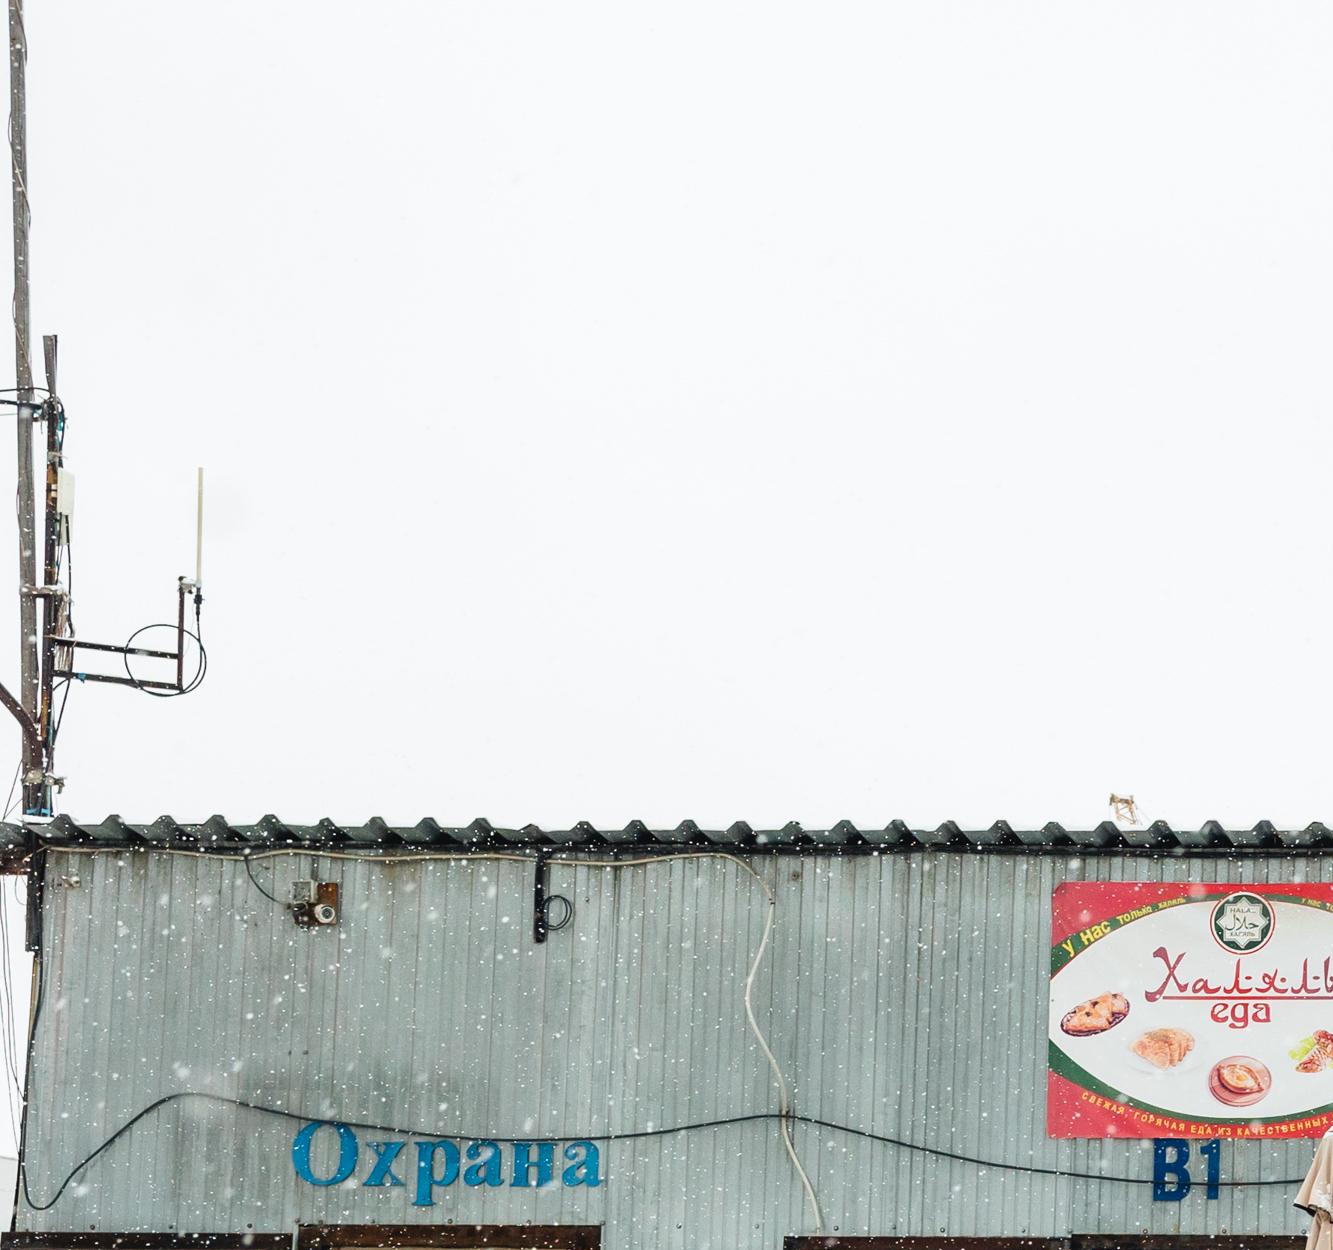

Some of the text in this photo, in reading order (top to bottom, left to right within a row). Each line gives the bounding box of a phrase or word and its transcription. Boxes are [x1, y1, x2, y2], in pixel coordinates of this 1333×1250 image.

[1116, 905, 1153, 925] только
[1210, 1002, 1271, 1029] еда
[1133, 1113, 1185, 1132] ГОРЯЧАЯ
[1190, 1125, 1215, 1135] ЕДА
[1218, 1127, 1231, 1136] ИЗ
[1237, 1117, 1328, 1136] КАЧЕСТВЕННЫХ
[292, 1120, 605, 1206] Охрана
